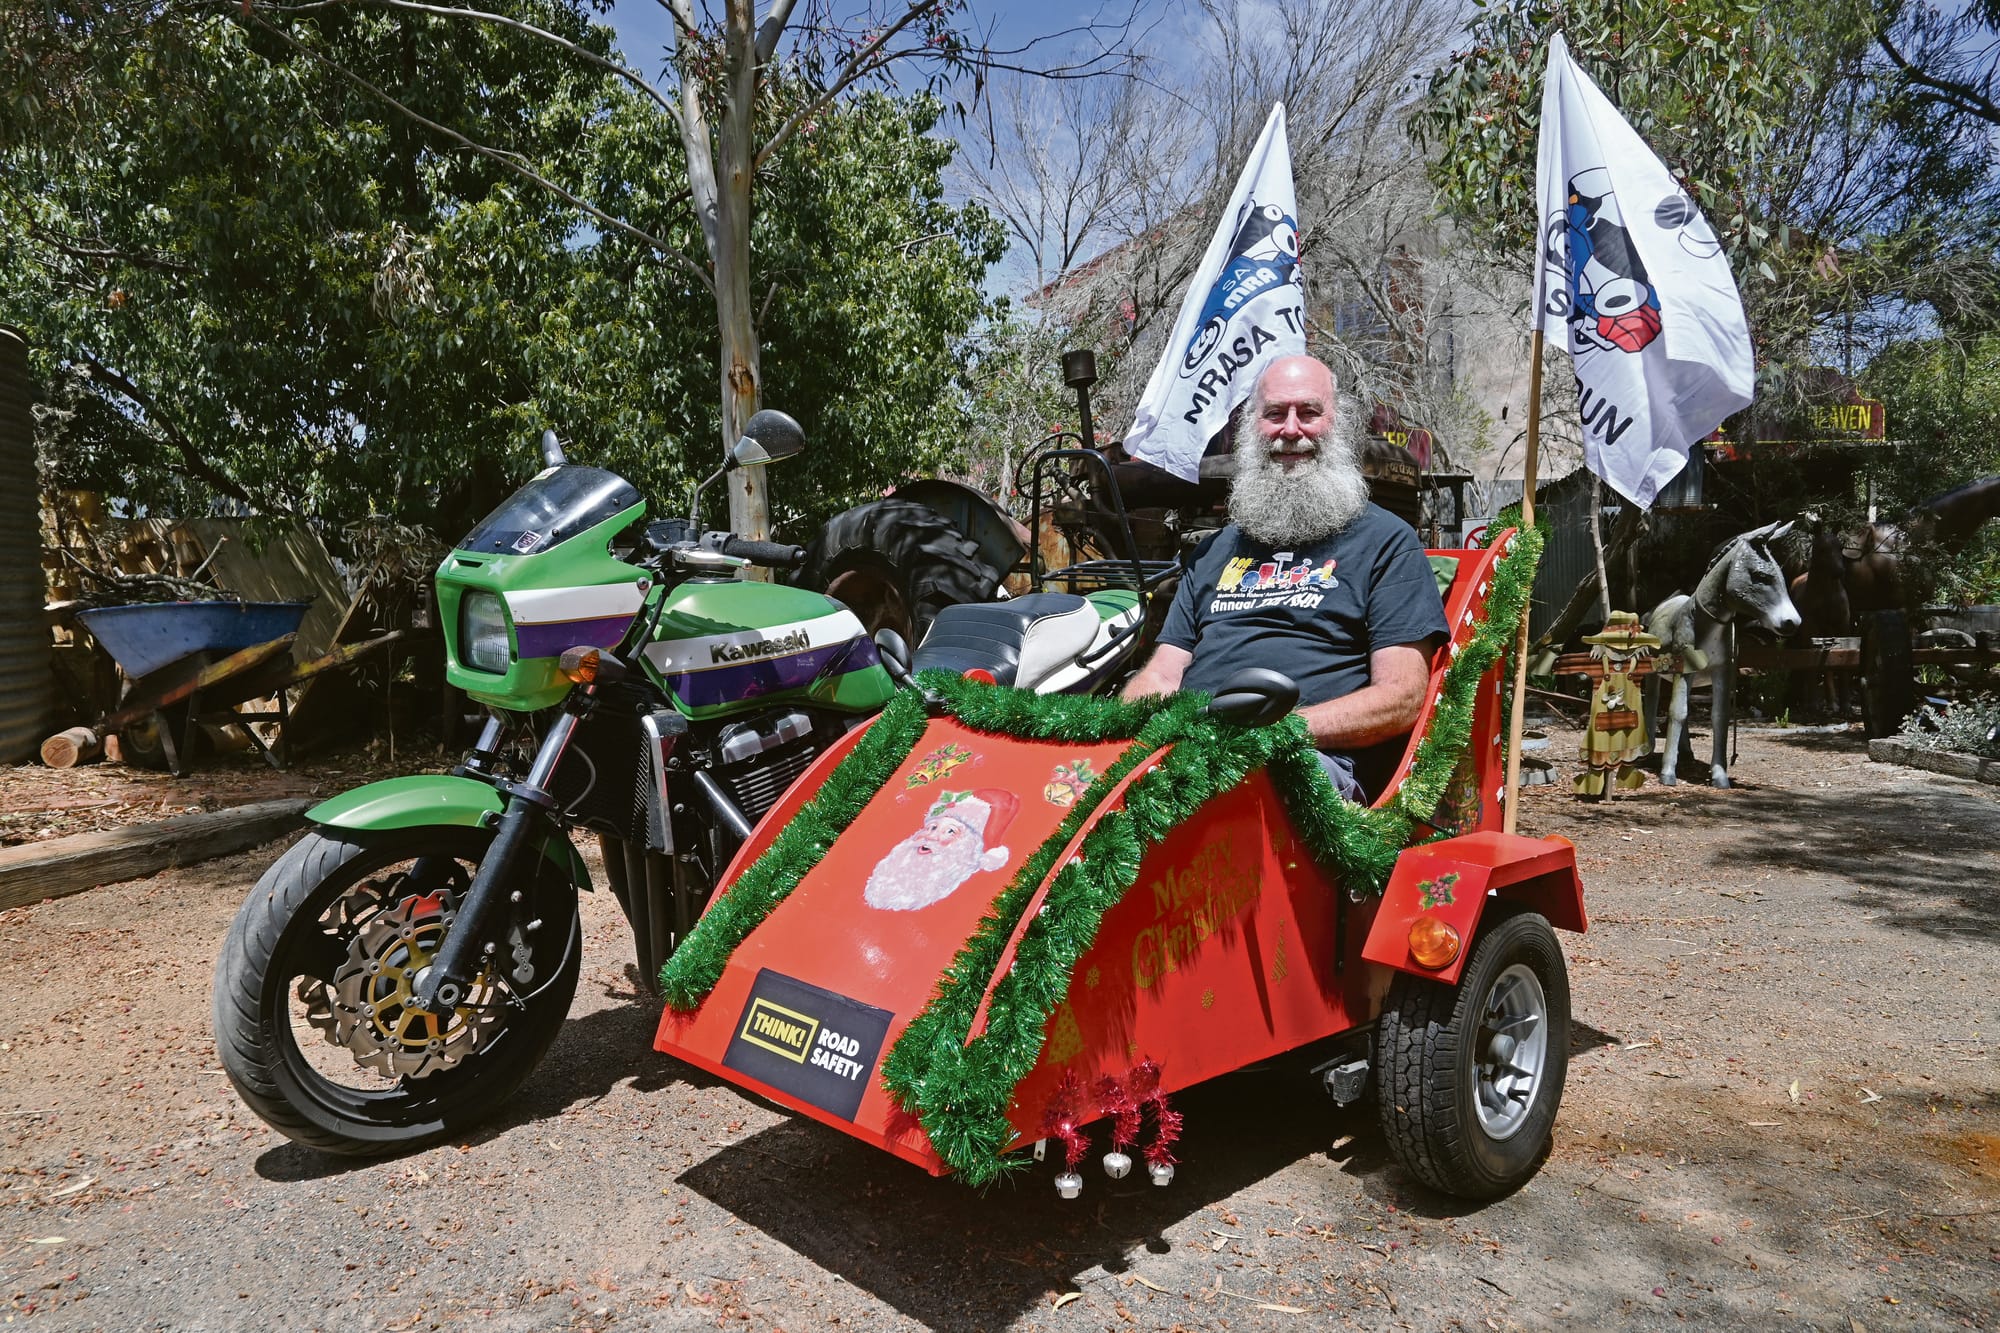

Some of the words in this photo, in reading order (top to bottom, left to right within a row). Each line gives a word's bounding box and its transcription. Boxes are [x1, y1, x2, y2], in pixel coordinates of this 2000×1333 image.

[1222, 268, 1251, 292] SA
[1183, 325, 1278, 425] MRASA
[1211, 599, 1256, 614] Annual
[709, 628, 811, 664] Kawasaki
[1151, 829, 1233, 921] Merry
[1132, 863, 1263, 989] Christmas
[753, 1011, 807, 1048] THINK!
[817, 1028, 860, 1057] ROAD
[810, 1047, 864, 1081] SAFETY
